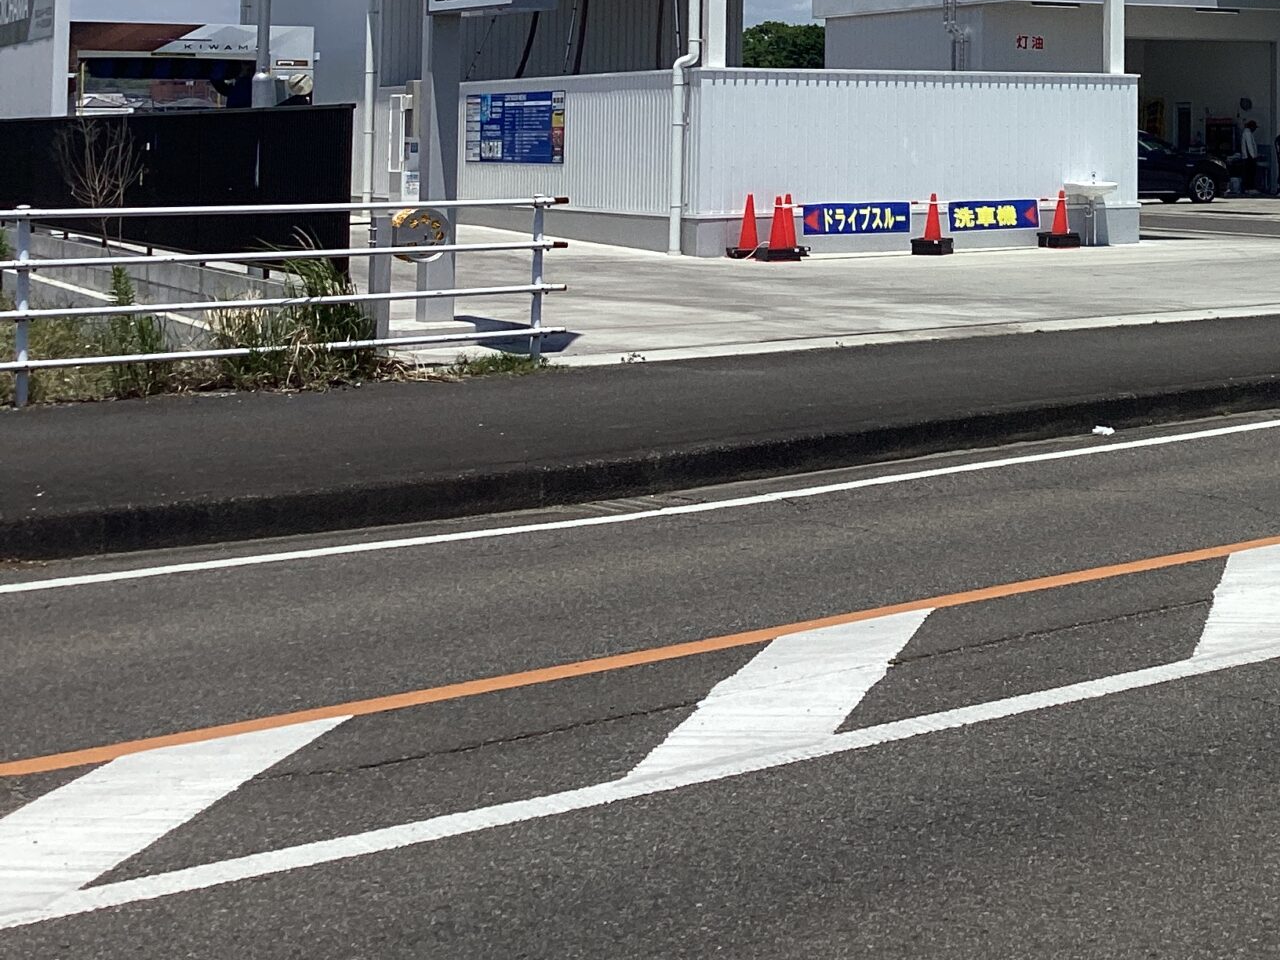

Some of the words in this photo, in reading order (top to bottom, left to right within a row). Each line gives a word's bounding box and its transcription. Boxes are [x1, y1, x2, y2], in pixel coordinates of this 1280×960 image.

[184, 43, 258, 51] KIWAM
[1016, 35, 1045, 50] 灯油
[823, 206, 906, 232] ドライブスルー
[953, 205, 1018, 229] 洗車機
